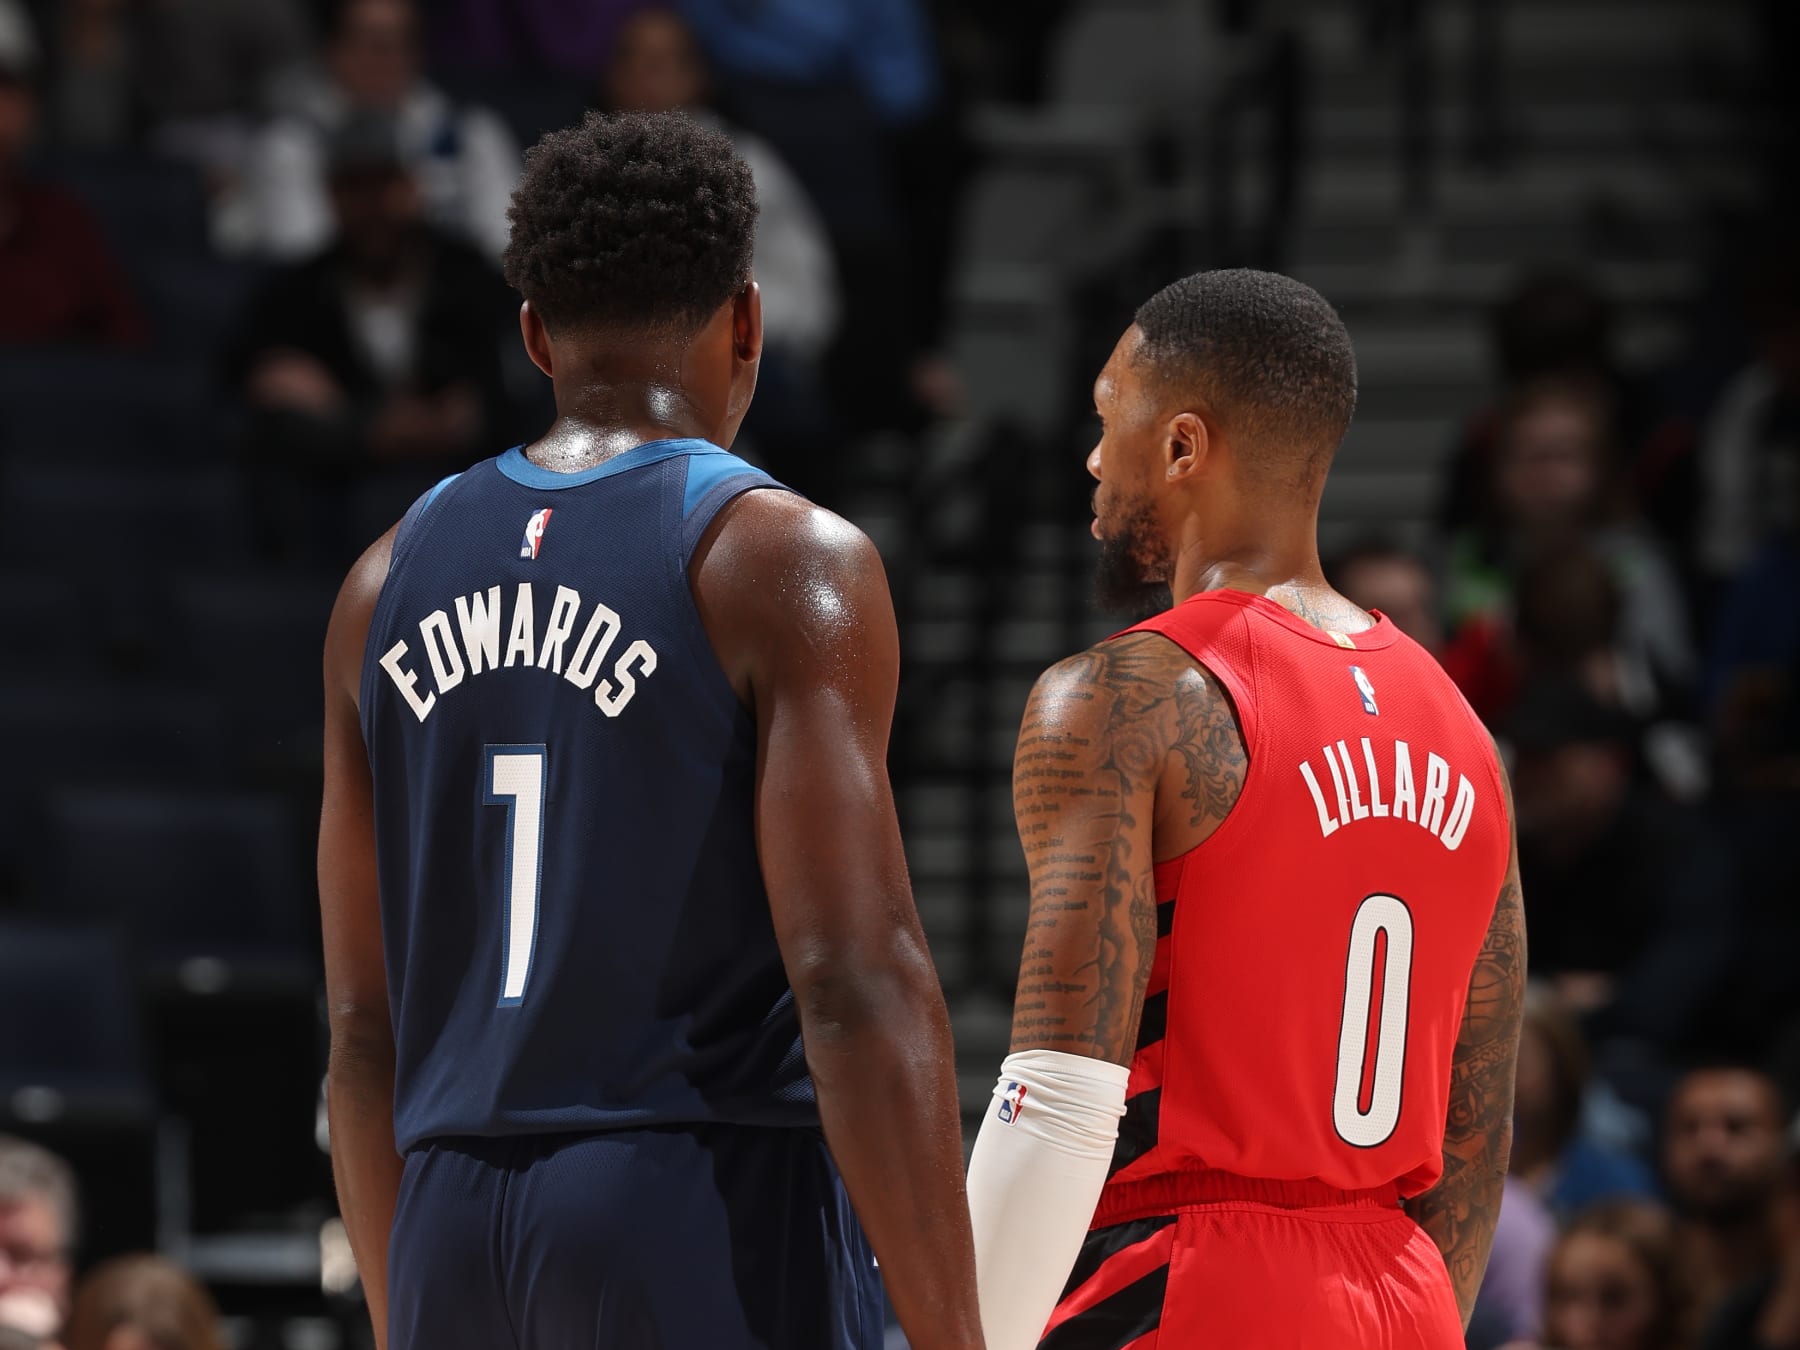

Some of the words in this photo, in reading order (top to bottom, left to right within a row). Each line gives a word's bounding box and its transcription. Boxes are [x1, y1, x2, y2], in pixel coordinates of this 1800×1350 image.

[379, 582, 658, 723] EDWARDS
[482, 743, 548, 1009] 1
[1298, 736, 1475, 851] LILLARD
[1332, 892, 1415, 1148] 0
